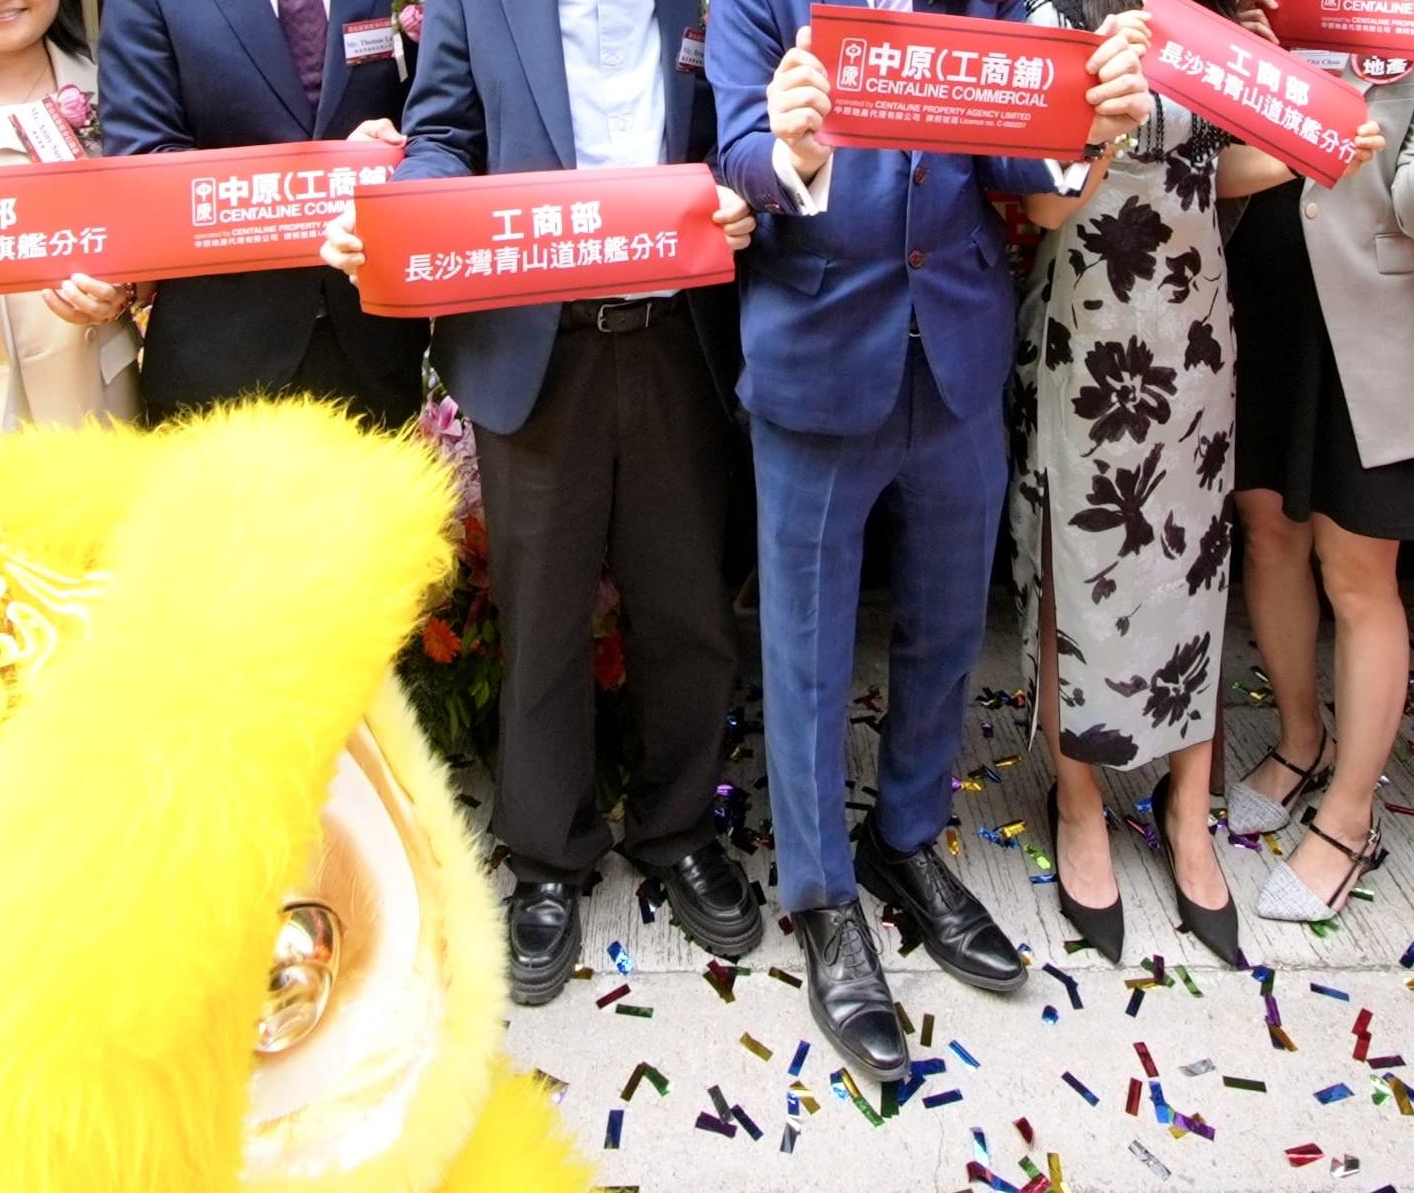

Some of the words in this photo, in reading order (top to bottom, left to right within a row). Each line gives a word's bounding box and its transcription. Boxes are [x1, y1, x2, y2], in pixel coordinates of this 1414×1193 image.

[1343, 0, 1414, 16] CENTALINE
[1363, 56, 1408, 75] 地產
[866, 78, 948, 99] CENTALINE
[952, 85, 1048, 107] COMMERCIAL
[875, 100, 921, 112] CENTALINE
[922, 104, 965, 116] PROPERTY
[966, 108, 999, 118] AGENCY
[1000, 111, 1031, 121] LIMITED
[220, 203, 301, 223] CENTALINE
[493, 200, 603, 241] 工商部
[232, 225, 277, 236] CENTALINE
[405, 231, 678, 283] 長沙灣青山道旗艦分行
